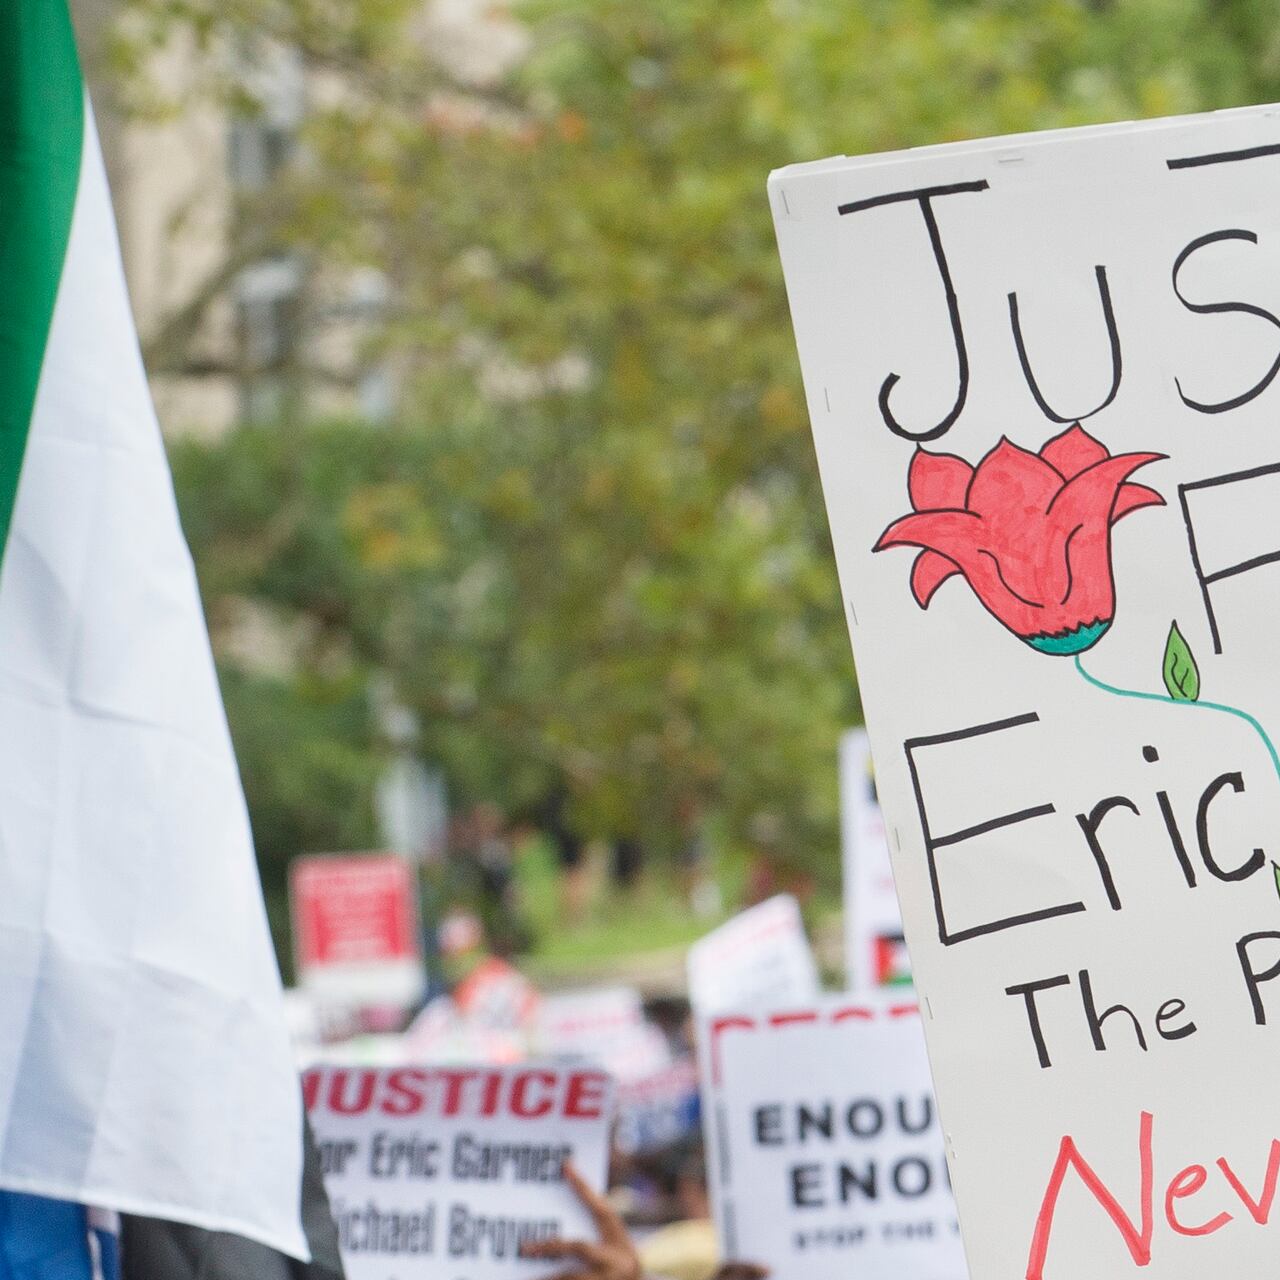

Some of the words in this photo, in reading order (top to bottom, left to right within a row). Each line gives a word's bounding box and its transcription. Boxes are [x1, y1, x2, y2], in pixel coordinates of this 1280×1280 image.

[905, 712, 1267, 944] Eric
[1006, 968, 1196, 1068] The
[754, 1096, 934, 1146] ENOU
[318, 1137, 359, 1179] or
[368, 1130, 441, 1179] Eric
[790, 1155, 950, 1208] ENO
[333, 1201, 437, 1254] ichael
